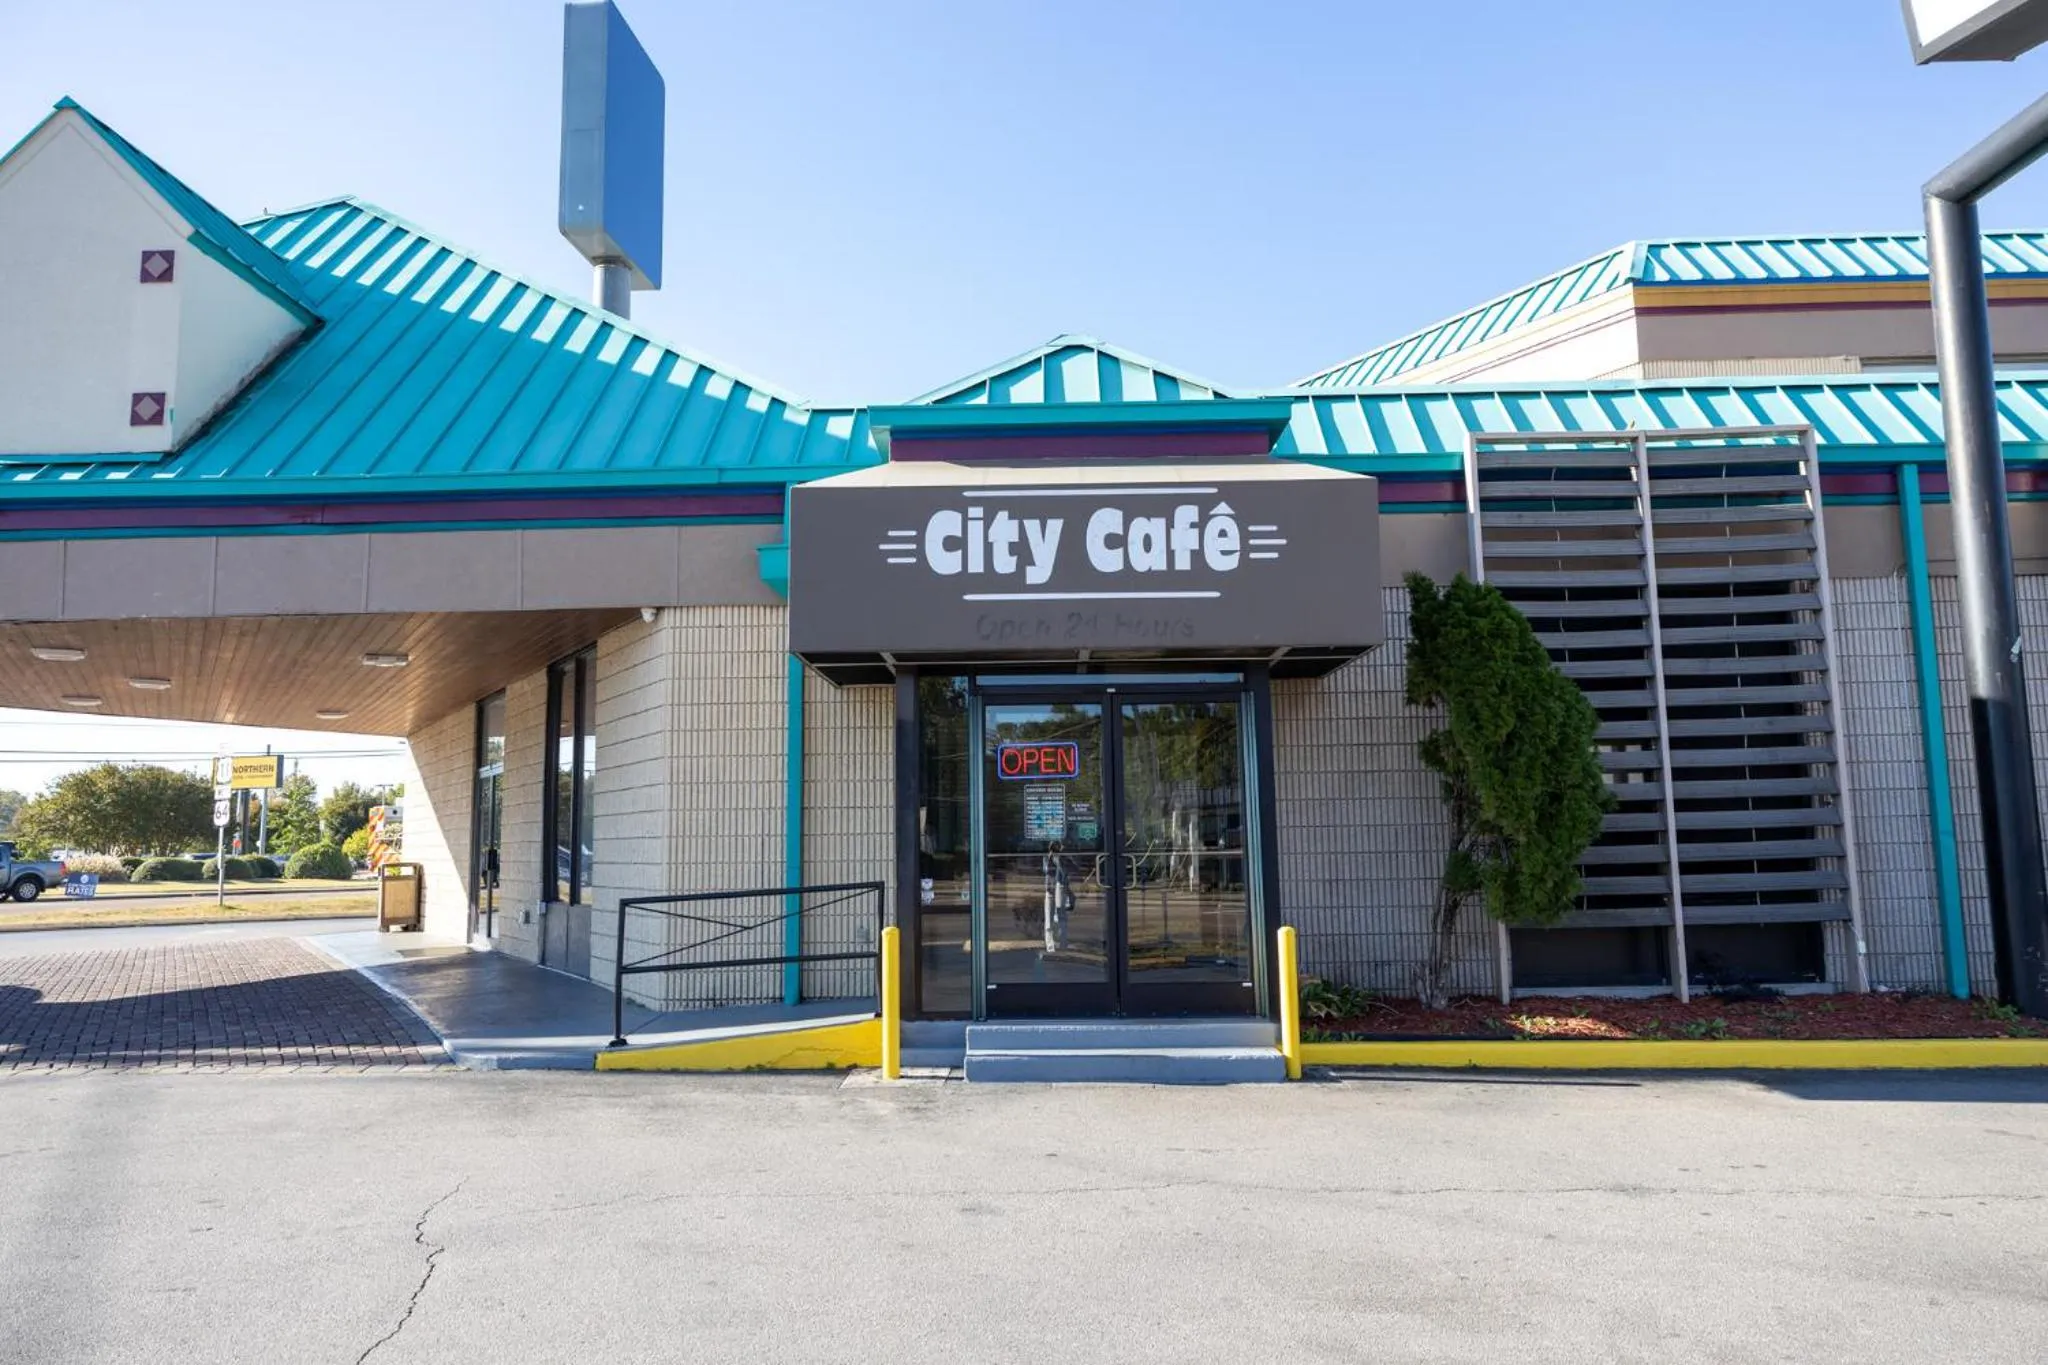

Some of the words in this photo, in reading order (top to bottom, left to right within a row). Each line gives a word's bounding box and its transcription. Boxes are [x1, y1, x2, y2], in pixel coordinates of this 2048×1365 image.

[925, 506, 1064, 585] City
[975, 613, 1050, 643] Open
[1114, 612, 1195, 640] Hours
[232, 764, 275, 774] NORTHERN
[1002, 747, 1075, 775] OPEN
[215, 804, 228, 820] 64
